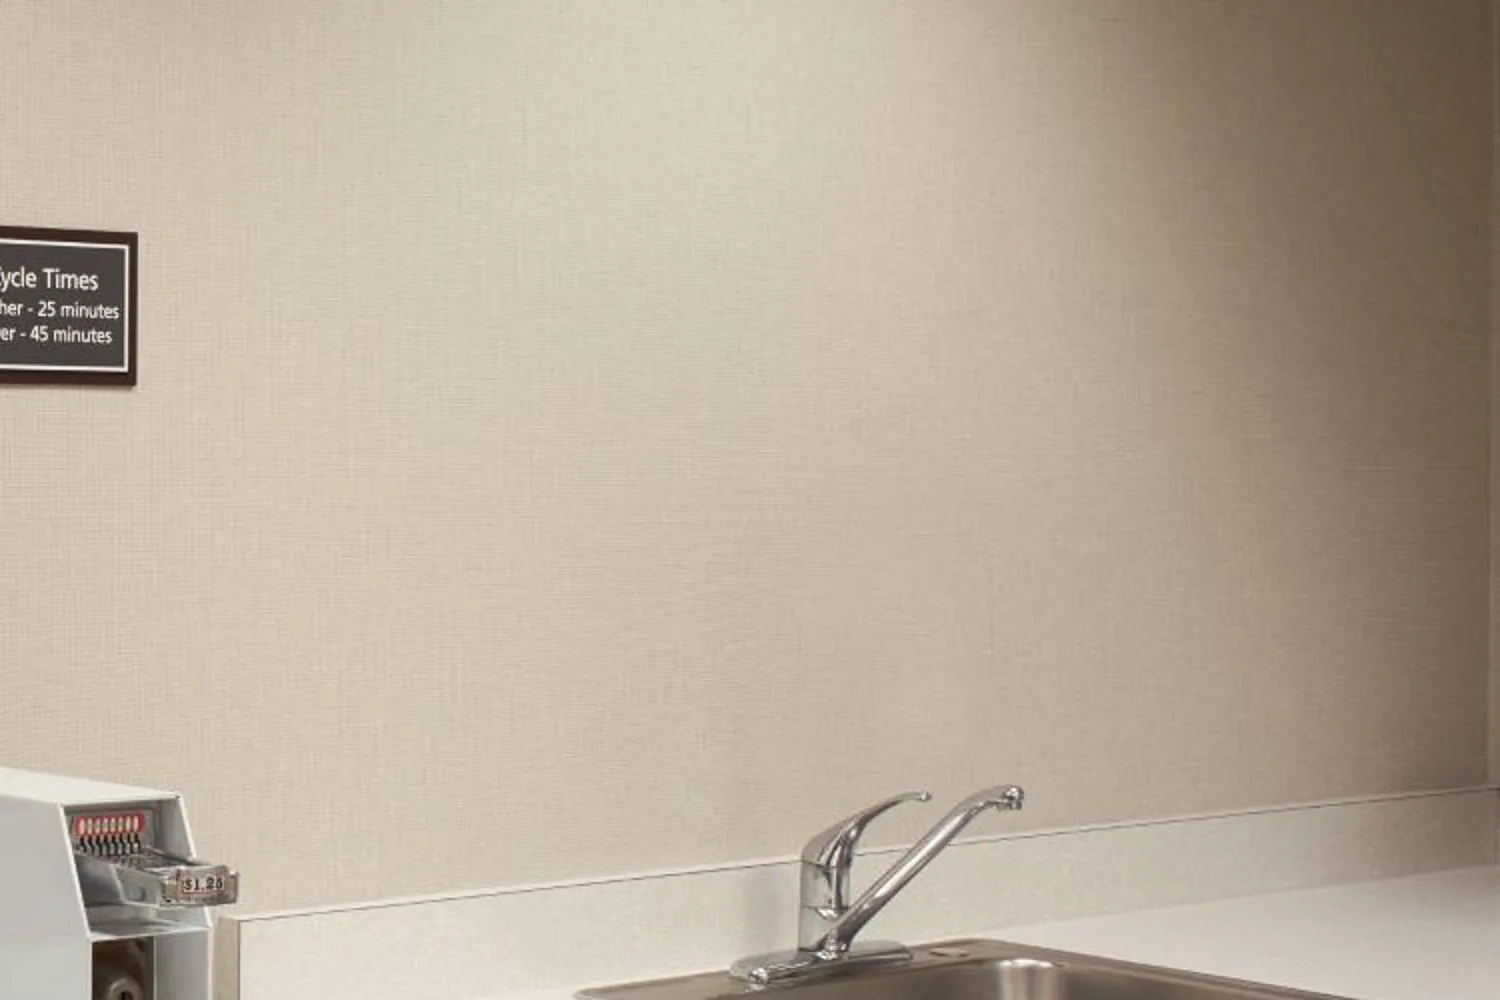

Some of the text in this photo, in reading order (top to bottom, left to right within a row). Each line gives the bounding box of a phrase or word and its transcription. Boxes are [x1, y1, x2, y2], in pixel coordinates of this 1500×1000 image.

[42, 268, 99, 291] Times
[37, 301, 56, 317] 25
[60, 302, 120, 319] minutes
[30, 325, 49, 342] 45
[53, 326, 113, 344] minutes
[184, 877, 223, 890] $1.25
